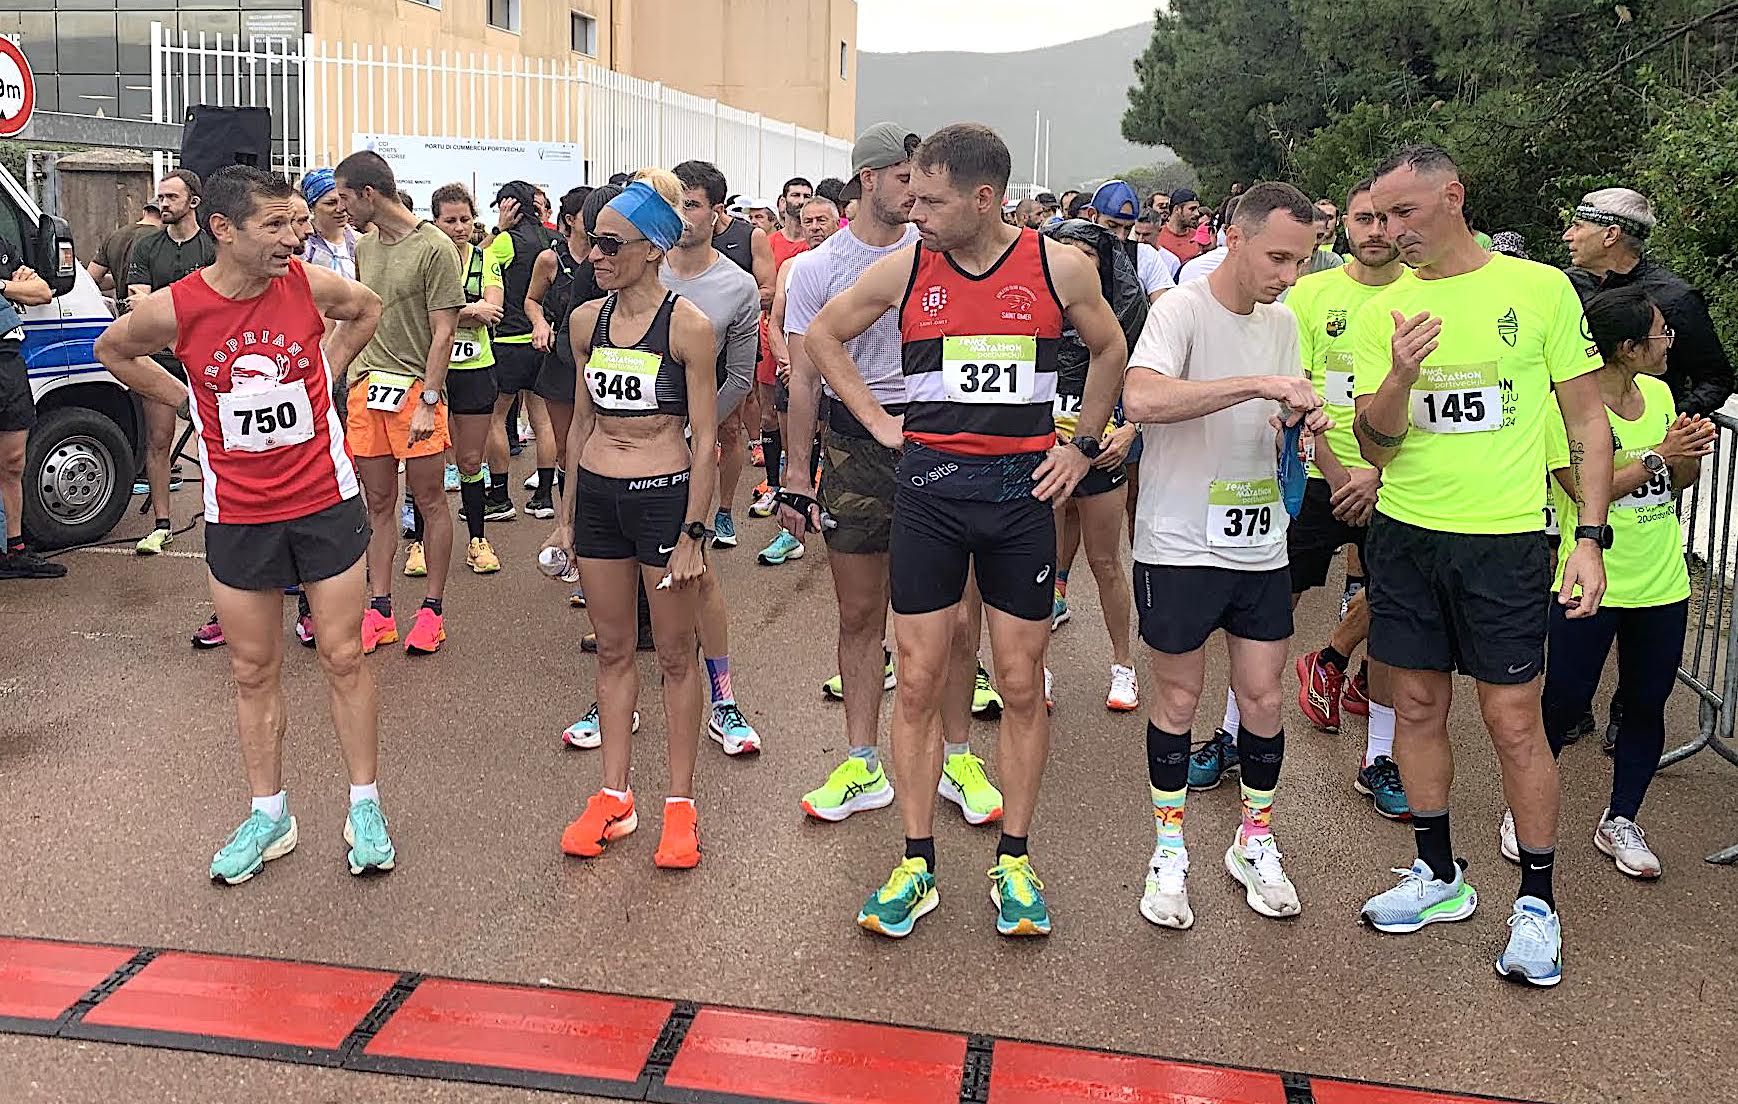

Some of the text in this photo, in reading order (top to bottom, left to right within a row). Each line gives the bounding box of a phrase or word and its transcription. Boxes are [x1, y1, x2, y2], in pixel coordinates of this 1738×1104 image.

[594, 371, 642, 401] 348
[960, 363, 1017, 393] 321
[366, 384, 406, 406] 377
[1423, 391, 1486, 423] 145
[233, 401, 297, 436] 750
[628, 476, 669, 491] NIKE
[1223, 506, 1271, 537] 379
